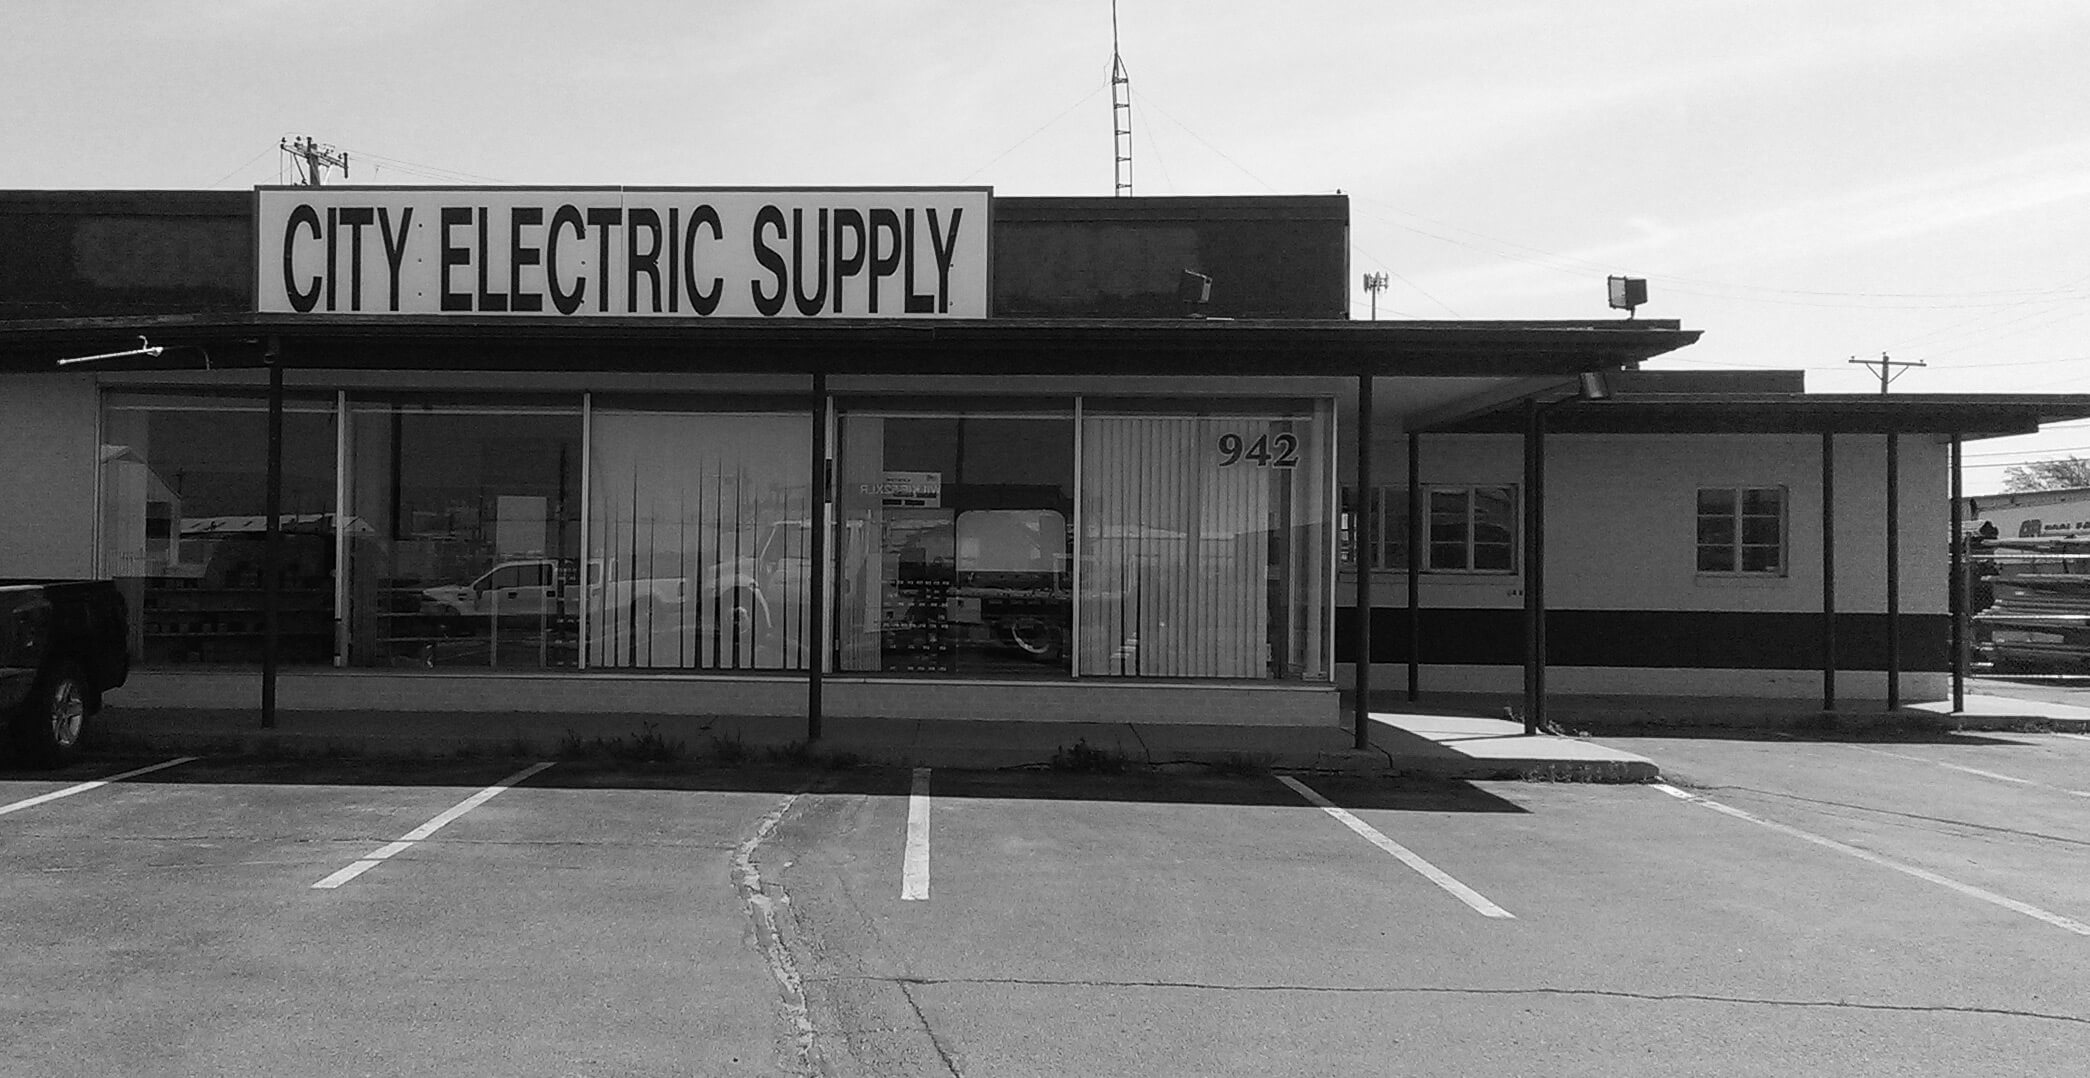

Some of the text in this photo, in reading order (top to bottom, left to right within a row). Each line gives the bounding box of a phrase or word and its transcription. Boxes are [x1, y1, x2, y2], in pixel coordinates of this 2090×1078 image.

[284, 204, 963, 316] CITY ELECTRIC SUPPLY
[1217, 432, 1300, 468] 942
